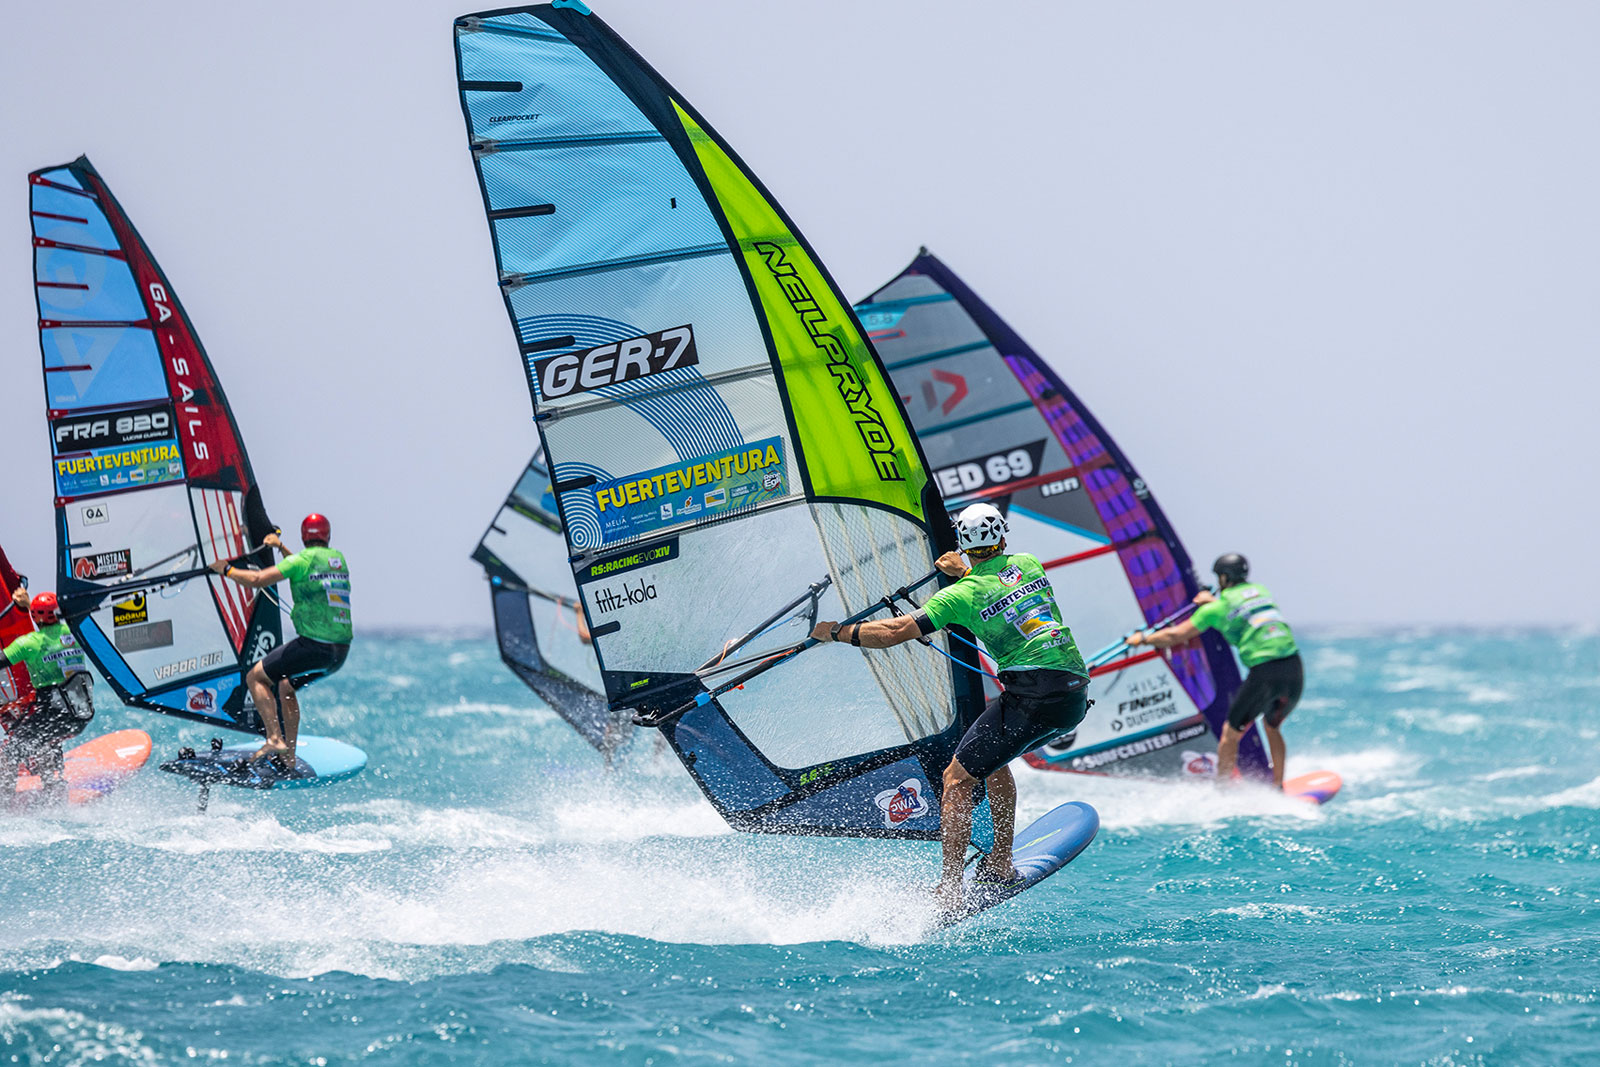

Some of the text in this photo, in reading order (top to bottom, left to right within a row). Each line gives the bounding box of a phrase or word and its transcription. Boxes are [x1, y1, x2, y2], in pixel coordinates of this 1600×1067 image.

[542, 327, 692, 398] GER-7
[753, 242, 906, 481] NEILPRYDE
[172, 357, 209, 460] SAILS
[56, 412, 169, 443] FRA 820
[57, 444, 180, 476] FUERTEVENTURA
[985, 449, 1034, 483] 69
[596, 445, 780, 512] FUERTEVENTURA
[96, 551, 127, 566] MISTRAL
[594, 578, 657, 613] fritz-kola
[153, 650, 223, 680] VAPOR AIR
[1118, 689, 1172, 715] FINISH
[1125, 702, 1179, 728] DUOTONE
[800, 768, 818, 786] 5.6
